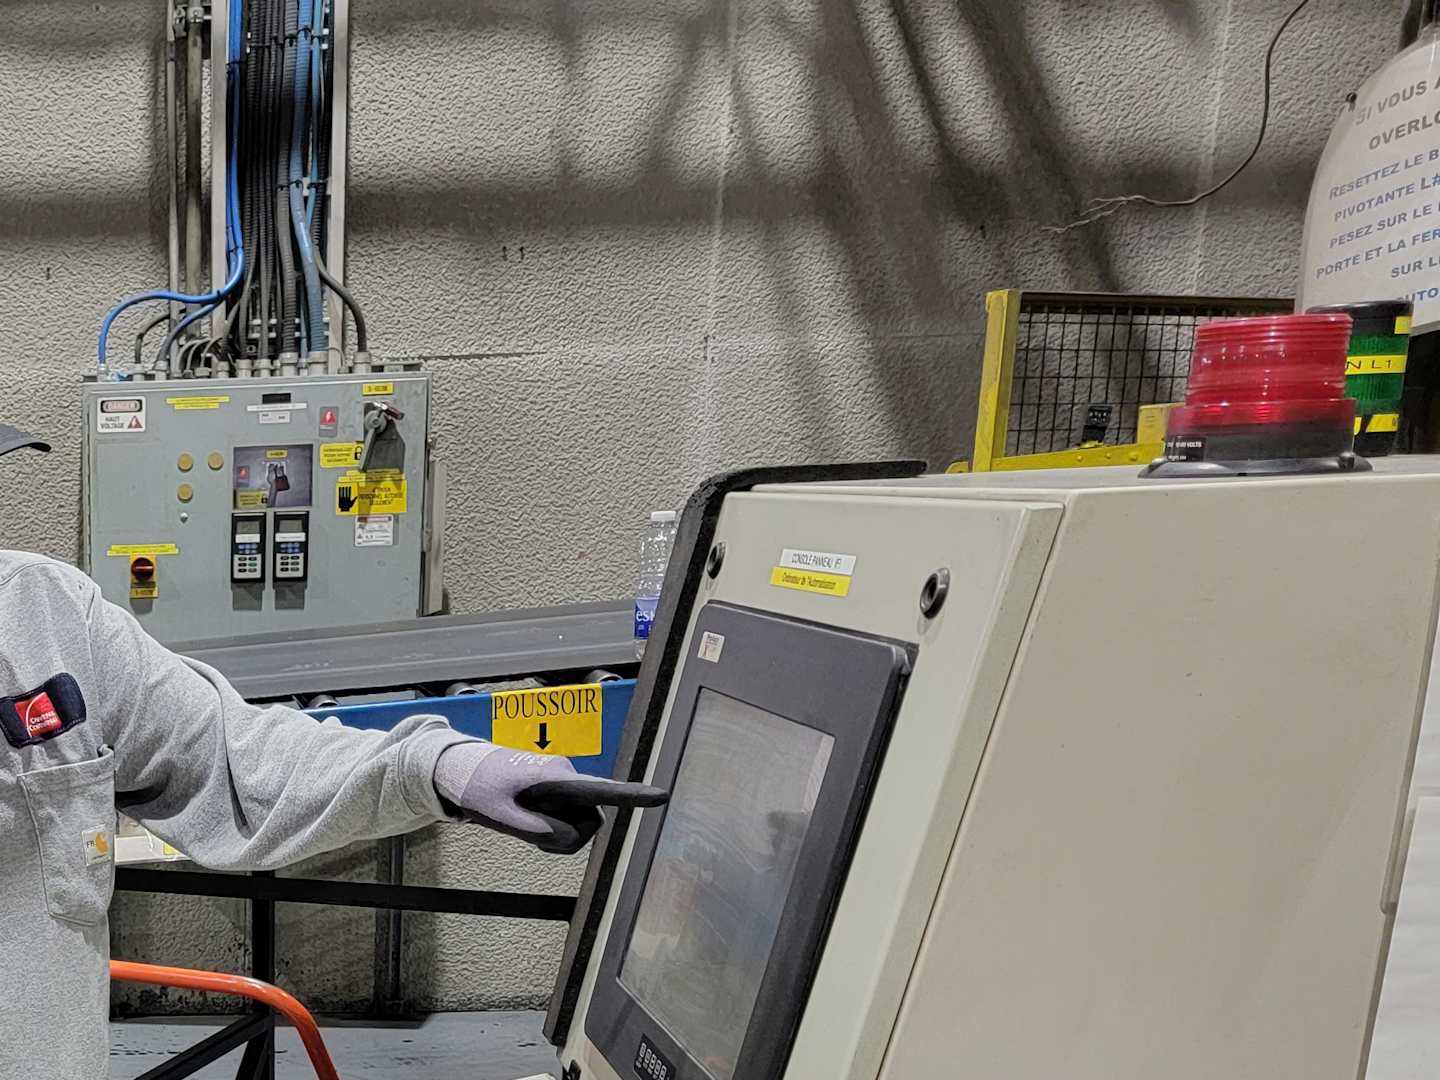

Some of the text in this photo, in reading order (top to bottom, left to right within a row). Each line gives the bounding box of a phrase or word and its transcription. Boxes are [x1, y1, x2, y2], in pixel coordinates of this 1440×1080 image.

[1377, 80, 1427, 113] VOUS
[1329, 162, 1401, 200] RESETTEZ
[1404, 154, 1423, 169] LE
[1335, 183, 1415, 222] PIVOTANTE
[1329, 204, 1433, 248] PESEZ SUR LE
[1316, 255, 1360, 279] PORTE
[1365, 246, 1383, 261] ET
[1388, 239, 1406, 253] LA
[1391, 260, 1423, 278] SUR
[494, 688, 598, 720] POUSSOIR
